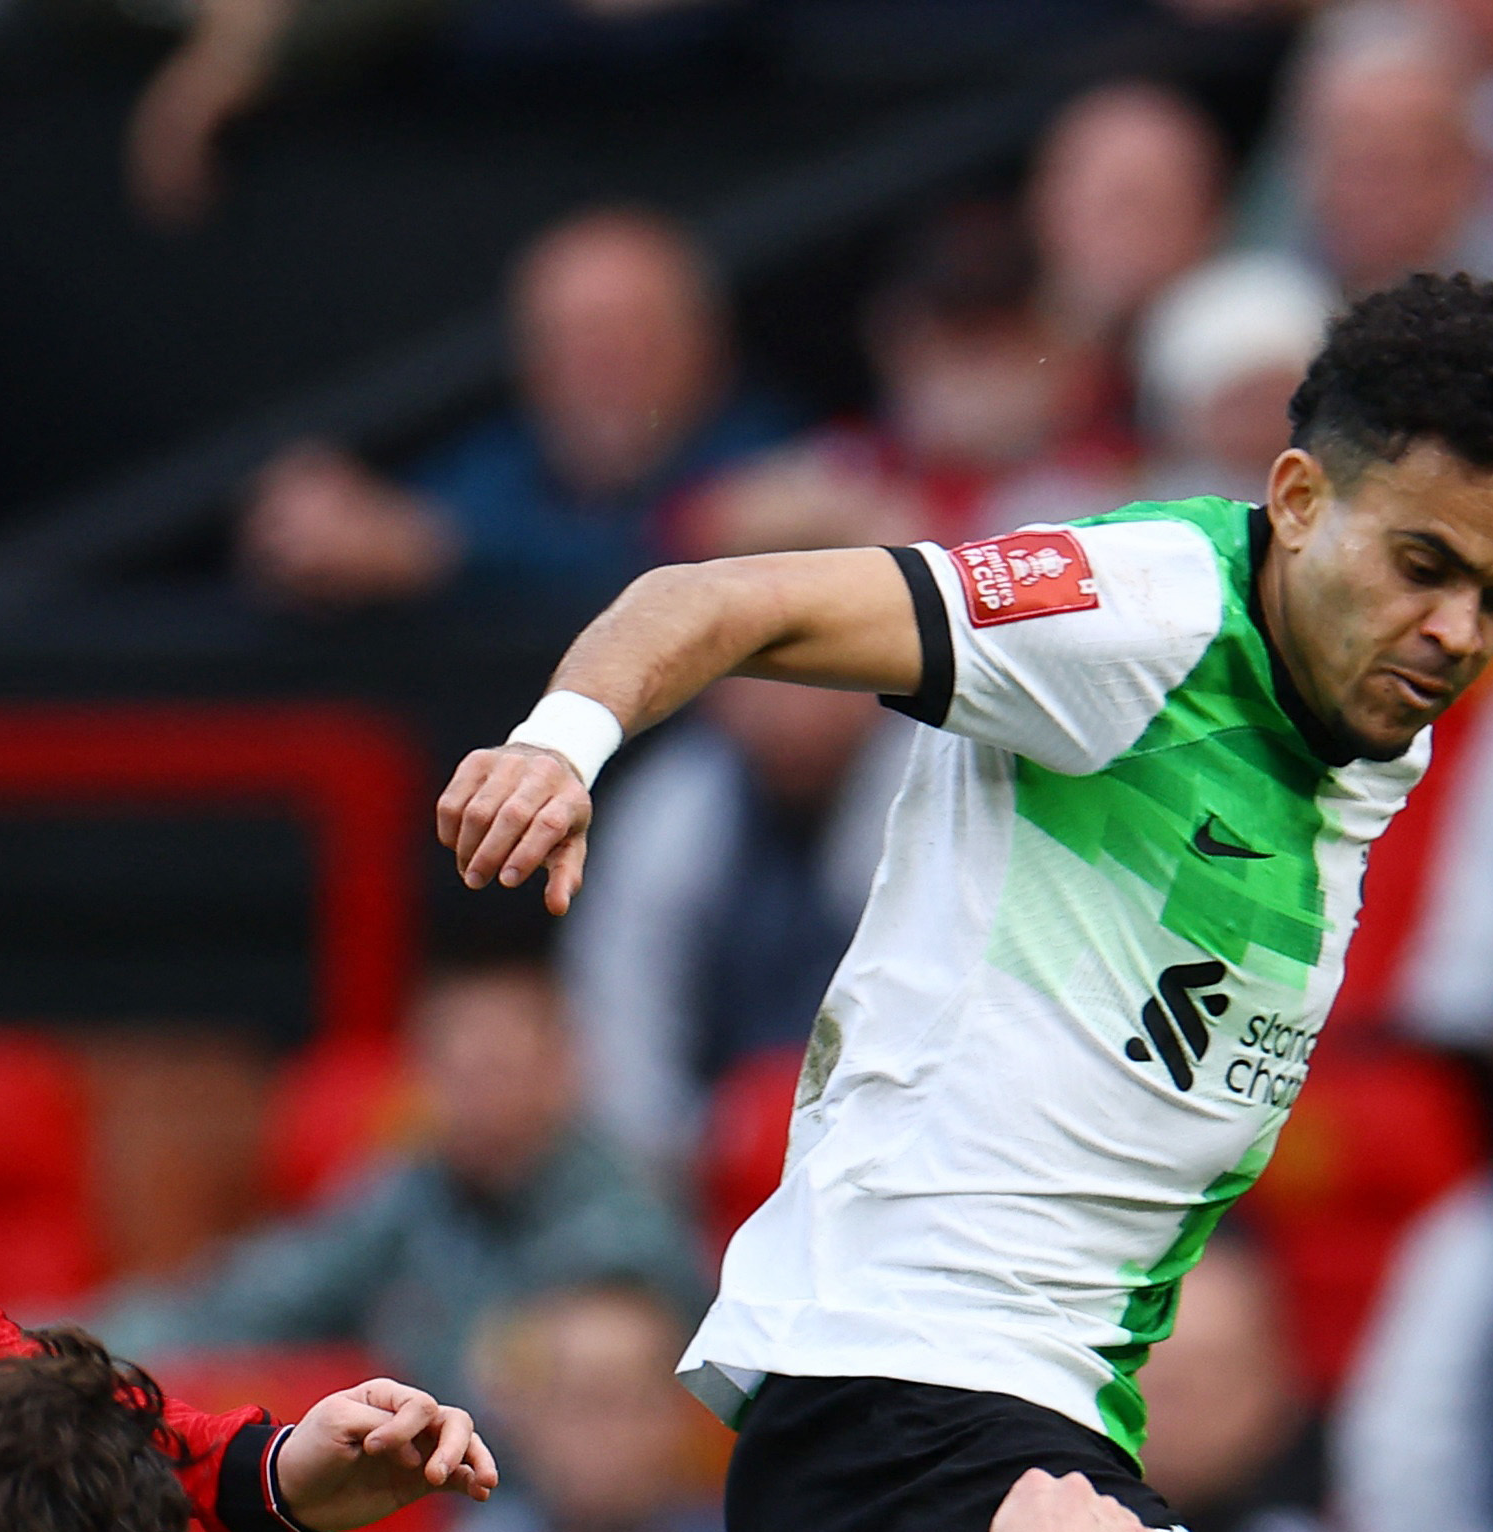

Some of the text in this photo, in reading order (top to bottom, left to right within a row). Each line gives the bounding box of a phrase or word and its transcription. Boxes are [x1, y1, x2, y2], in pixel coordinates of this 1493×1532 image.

[972, 566, 1001, 610] CUP
[979, 544, 1015, 606] Emirates
[1225, 1058, 1303, 1109] char
